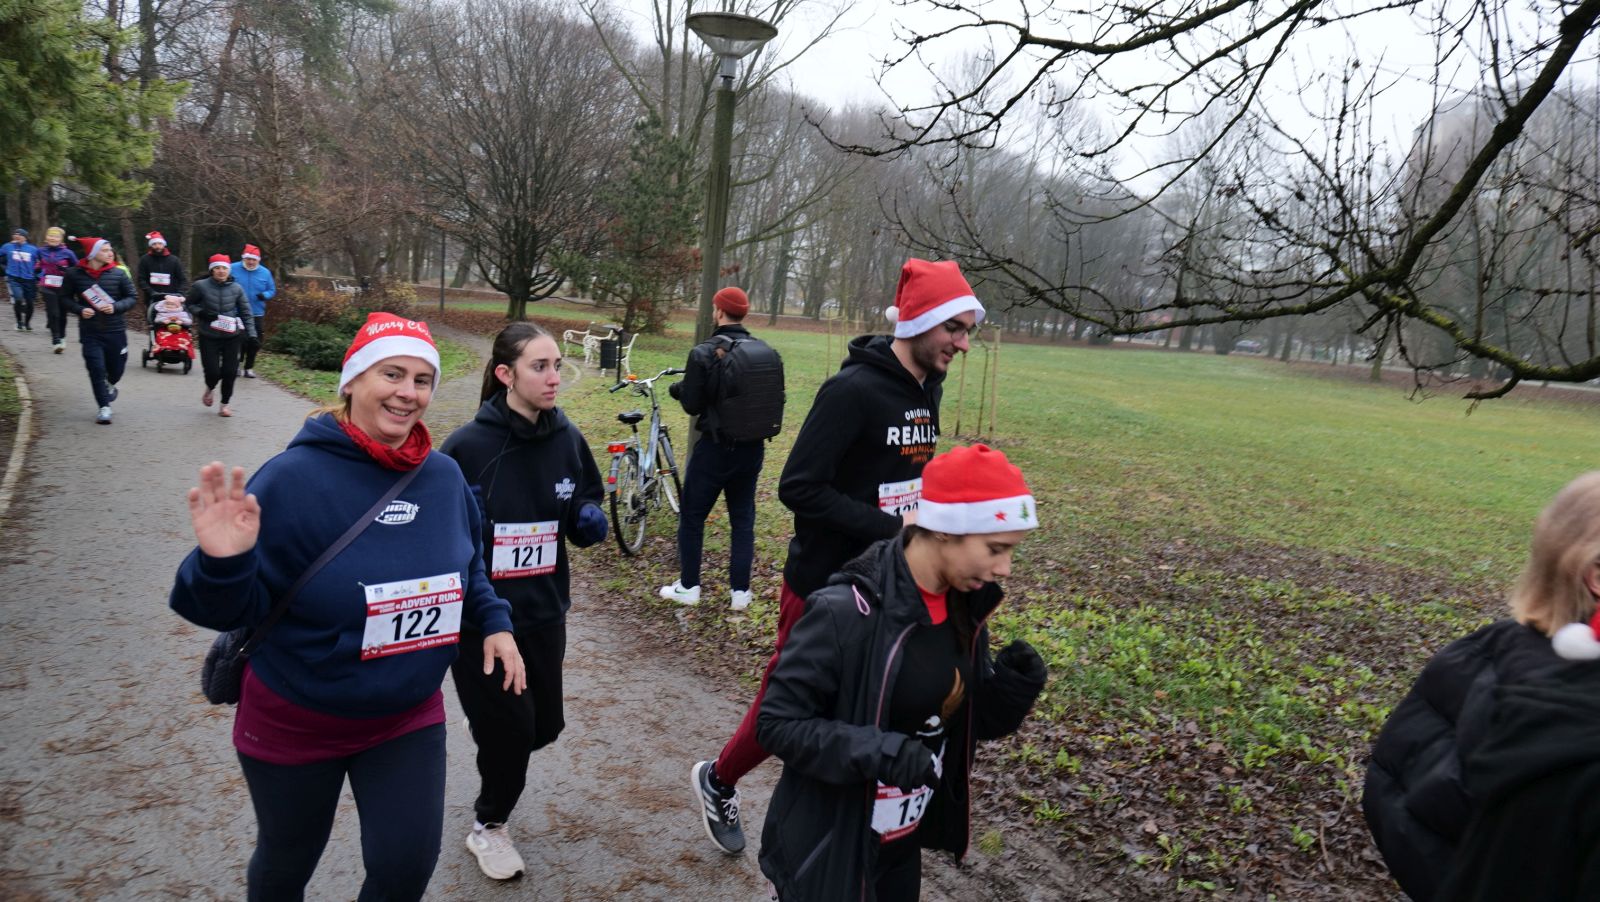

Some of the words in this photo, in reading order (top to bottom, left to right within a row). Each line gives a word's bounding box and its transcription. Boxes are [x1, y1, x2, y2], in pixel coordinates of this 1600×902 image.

[366, 321, 404, 336] Merry
[512, 545, 543, 568] 121
[392, 606, 441, 642] 122
[899, 793, 926, 826] 13
